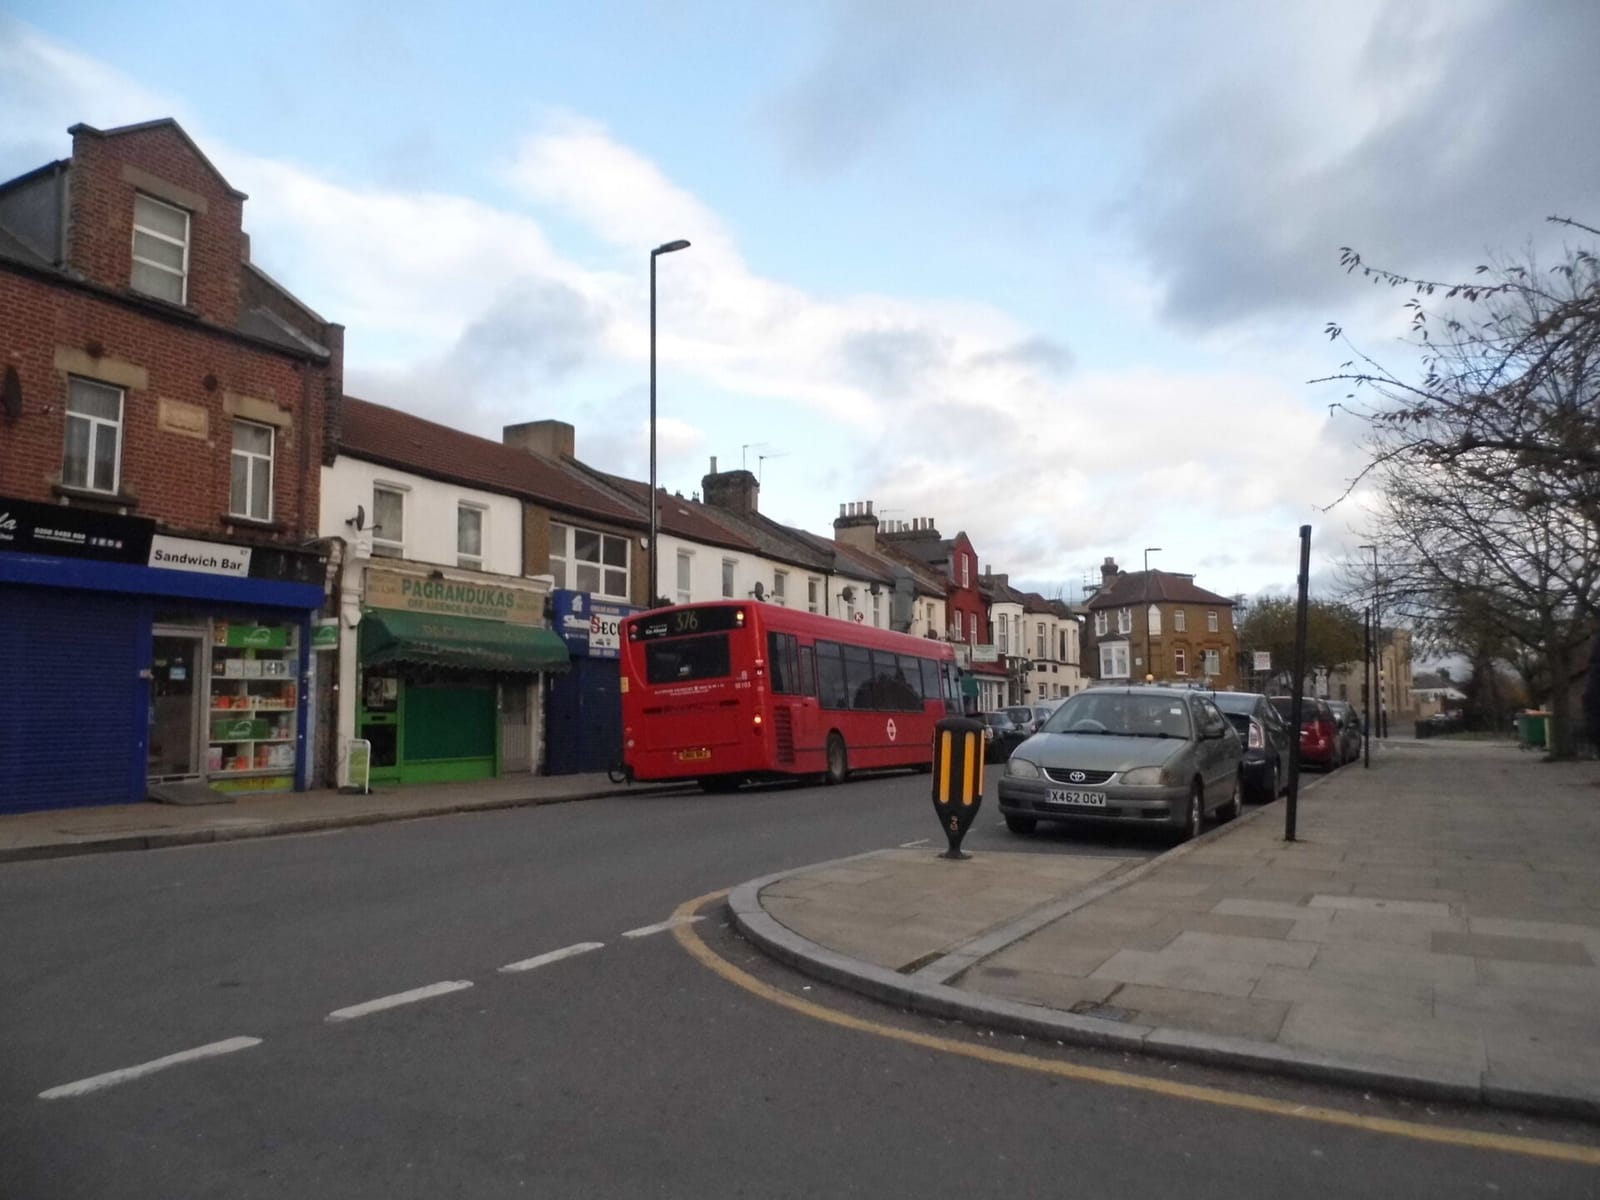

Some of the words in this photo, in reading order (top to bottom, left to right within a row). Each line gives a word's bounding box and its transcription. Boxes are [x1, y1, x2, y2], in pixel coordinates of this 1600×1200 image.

[154, 549, 217, 567] Sandwich
[221, 557, 243, 570] Bar
[401, 578, 515, 608] PAGRANDUKAS
[675, 610, 698, 632] 376
[1052, 791, 1080, 803] X462
[1083, 792, 1104, 805] OGV
